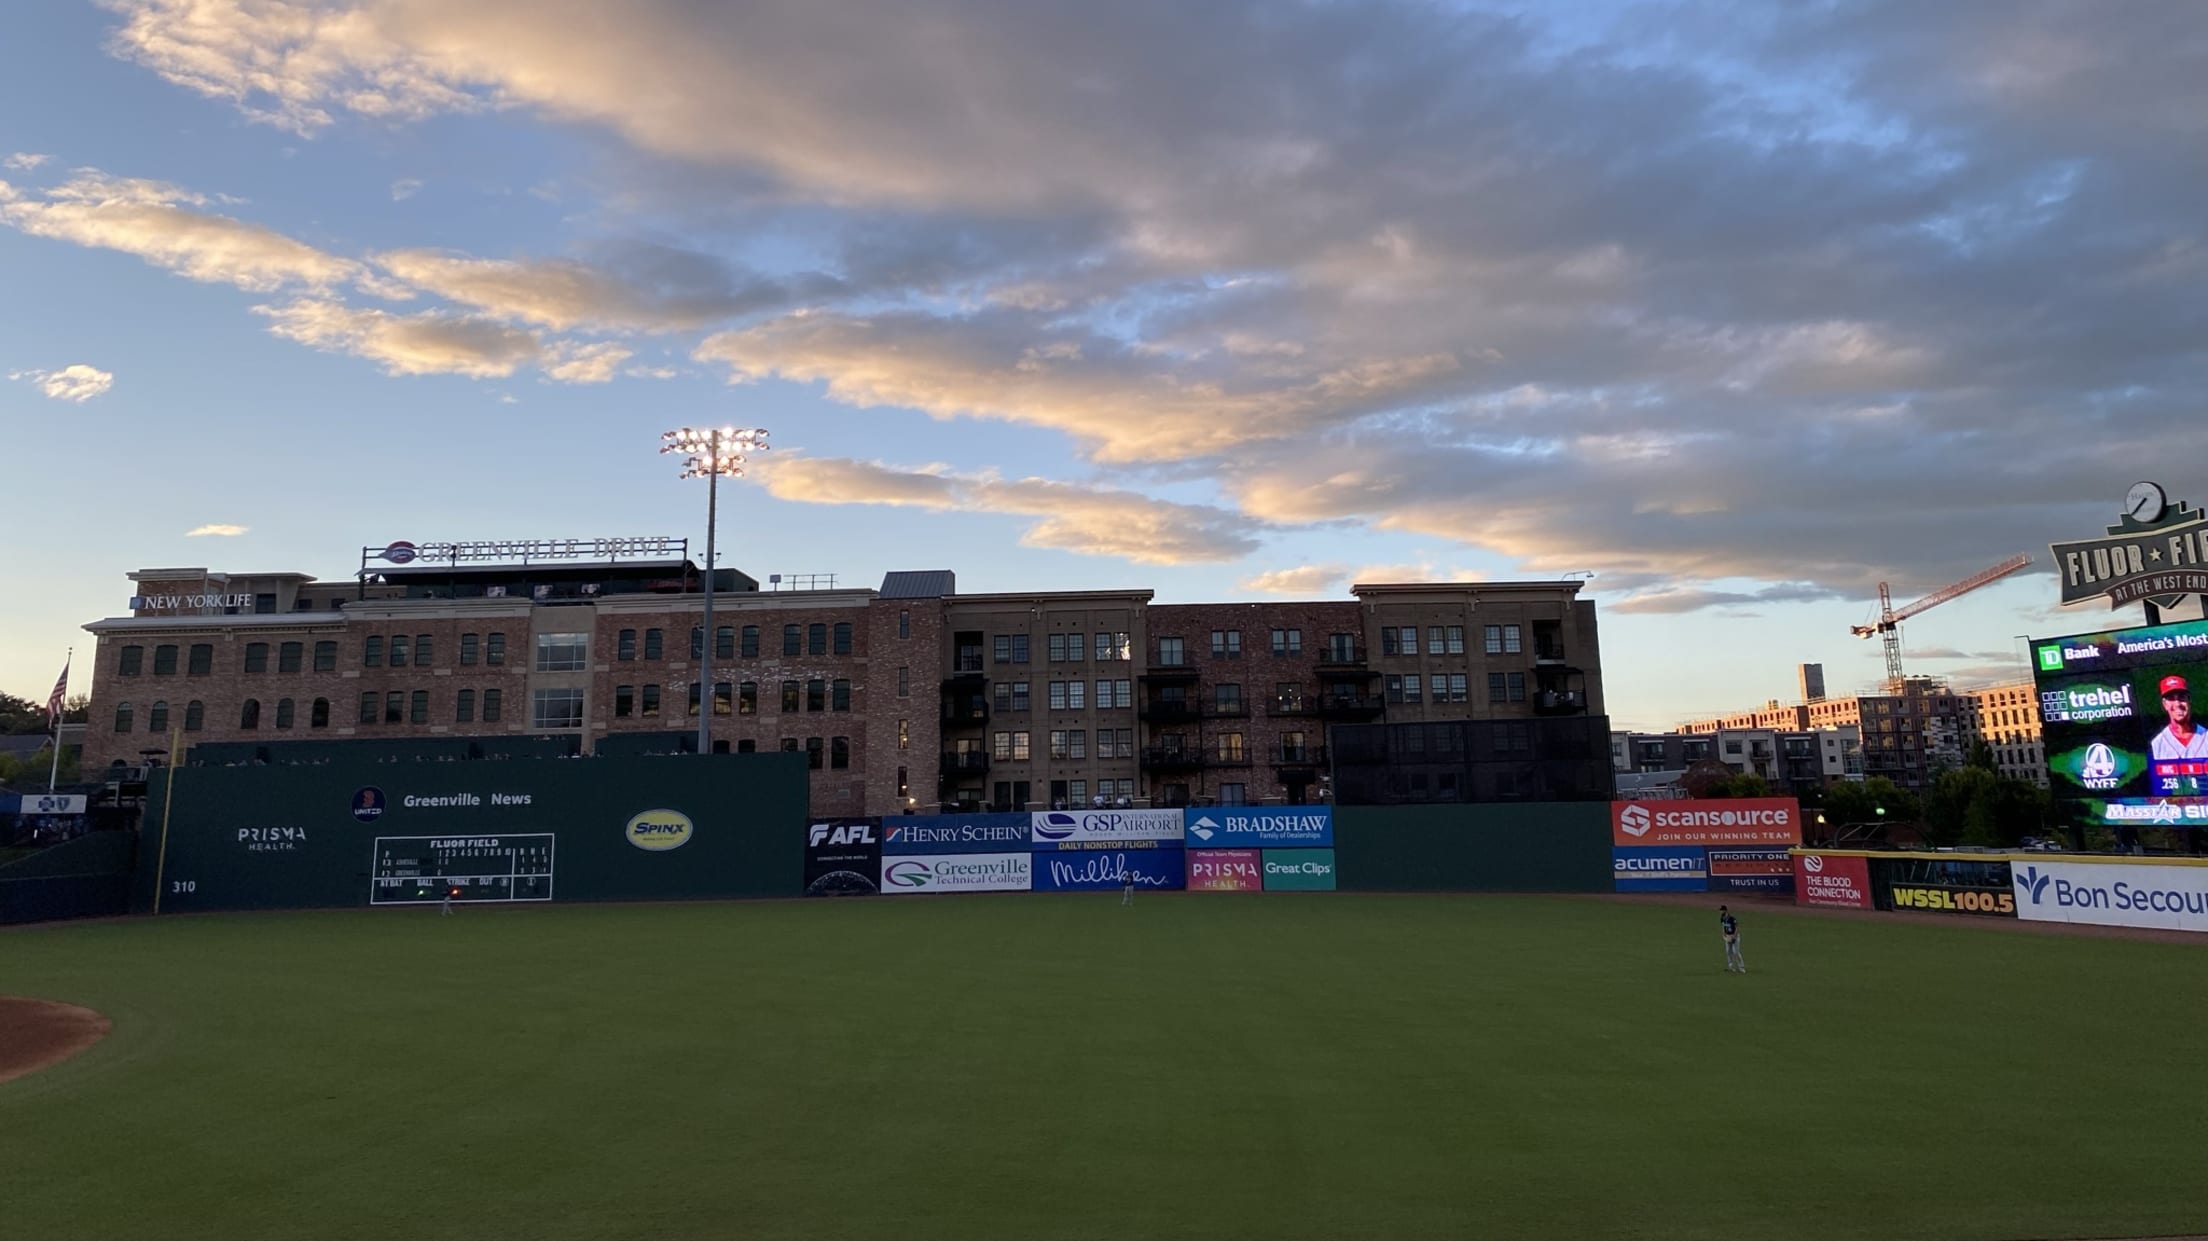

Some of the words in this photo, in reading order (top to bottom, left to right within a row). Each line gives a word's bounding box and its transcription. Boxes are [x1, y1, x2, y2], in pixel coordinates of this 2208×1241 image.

[419, 538, 579, 562] GREENVILLE
[594, 536, 671, 557] DRIVE
[2067, 545, 2145, 586] FLUOR
[2115, 586, 2130, 601] AT
[2130, 581, 2150, 596] THE
[2152, 575, 2185, 592] WEST
[2186, 575, 2207, 589] END
[145, 595, 182, 609] NEW
[185, 594, 223, 608] YORK
[225, 593, 252, 607] LIFE
[2117, 636, 2174, 654] America's
[2176, 633, 2208, 648] Most
[2064, 645, 2100, 660] Bank
[2069, 685, 2130, 708] trehel
[2071, 706, 2132, 721] corporation
[2083, 777, 2119, 789] WYFF
[403, 793, 481, 807] Greenville
[491, 793, 532, 806] News
[354, 808, 383, 816] UNITED
[1655, 808, 1790, 827] scansource
[2185, 804, 2208, 818] SI
[633, 822, 685, 835] SPINX
[1083, 814, 1123, 832] GSP
[1123, 819, 1179, 831] AIRPORT
[1226, 815, 1327, 832] BRADSHAW
[238, 827, 306, 841] PRISMA
[903, 826, 960, 843] HENRY
[1656, 833, 1682, 841] JOIN
[1685, 832, 1707, 841] OUR
[1710, 832, 1758, 841] WINNING
[1761, 831, 1791, 840] TEAM
[430, 840, 466, 849] FLUOR
[467, 839, 499, 848] FIELD
[1058, 842, 1083, 850] DAILY
[1084, 841, 1124, 850] NONSTOP
[1124, 840, 1159, 849] FLIGHTS
[934, 859, 1028, 876] Greenville
[1193, 863, 1258, 877] PRISMA
[1265, 862, 1301, 874] Great
[1301, 862, 1331, 876] Clips
[416, 879, 434, 888] BALL
[446, 878, 471, 886] STRIKE
[479, 878, 494, 886] OUT
[935, 874, 985, 885] Technical
[988, 873, 1029, 885] College
[1730, 879, 1755, 887] TRUST
[1768, 878, 1780, 886] US
[1806, 875, 1822, 886] THE
[1823, 876, 1852, 888] BLOOD
[173, 881, 196, 893] 310
[1807, 886, 1861, 900] CONNECTION
[2055, 879, 2109, 909] Bon
[2114, 881, 2208, 914] Secou
